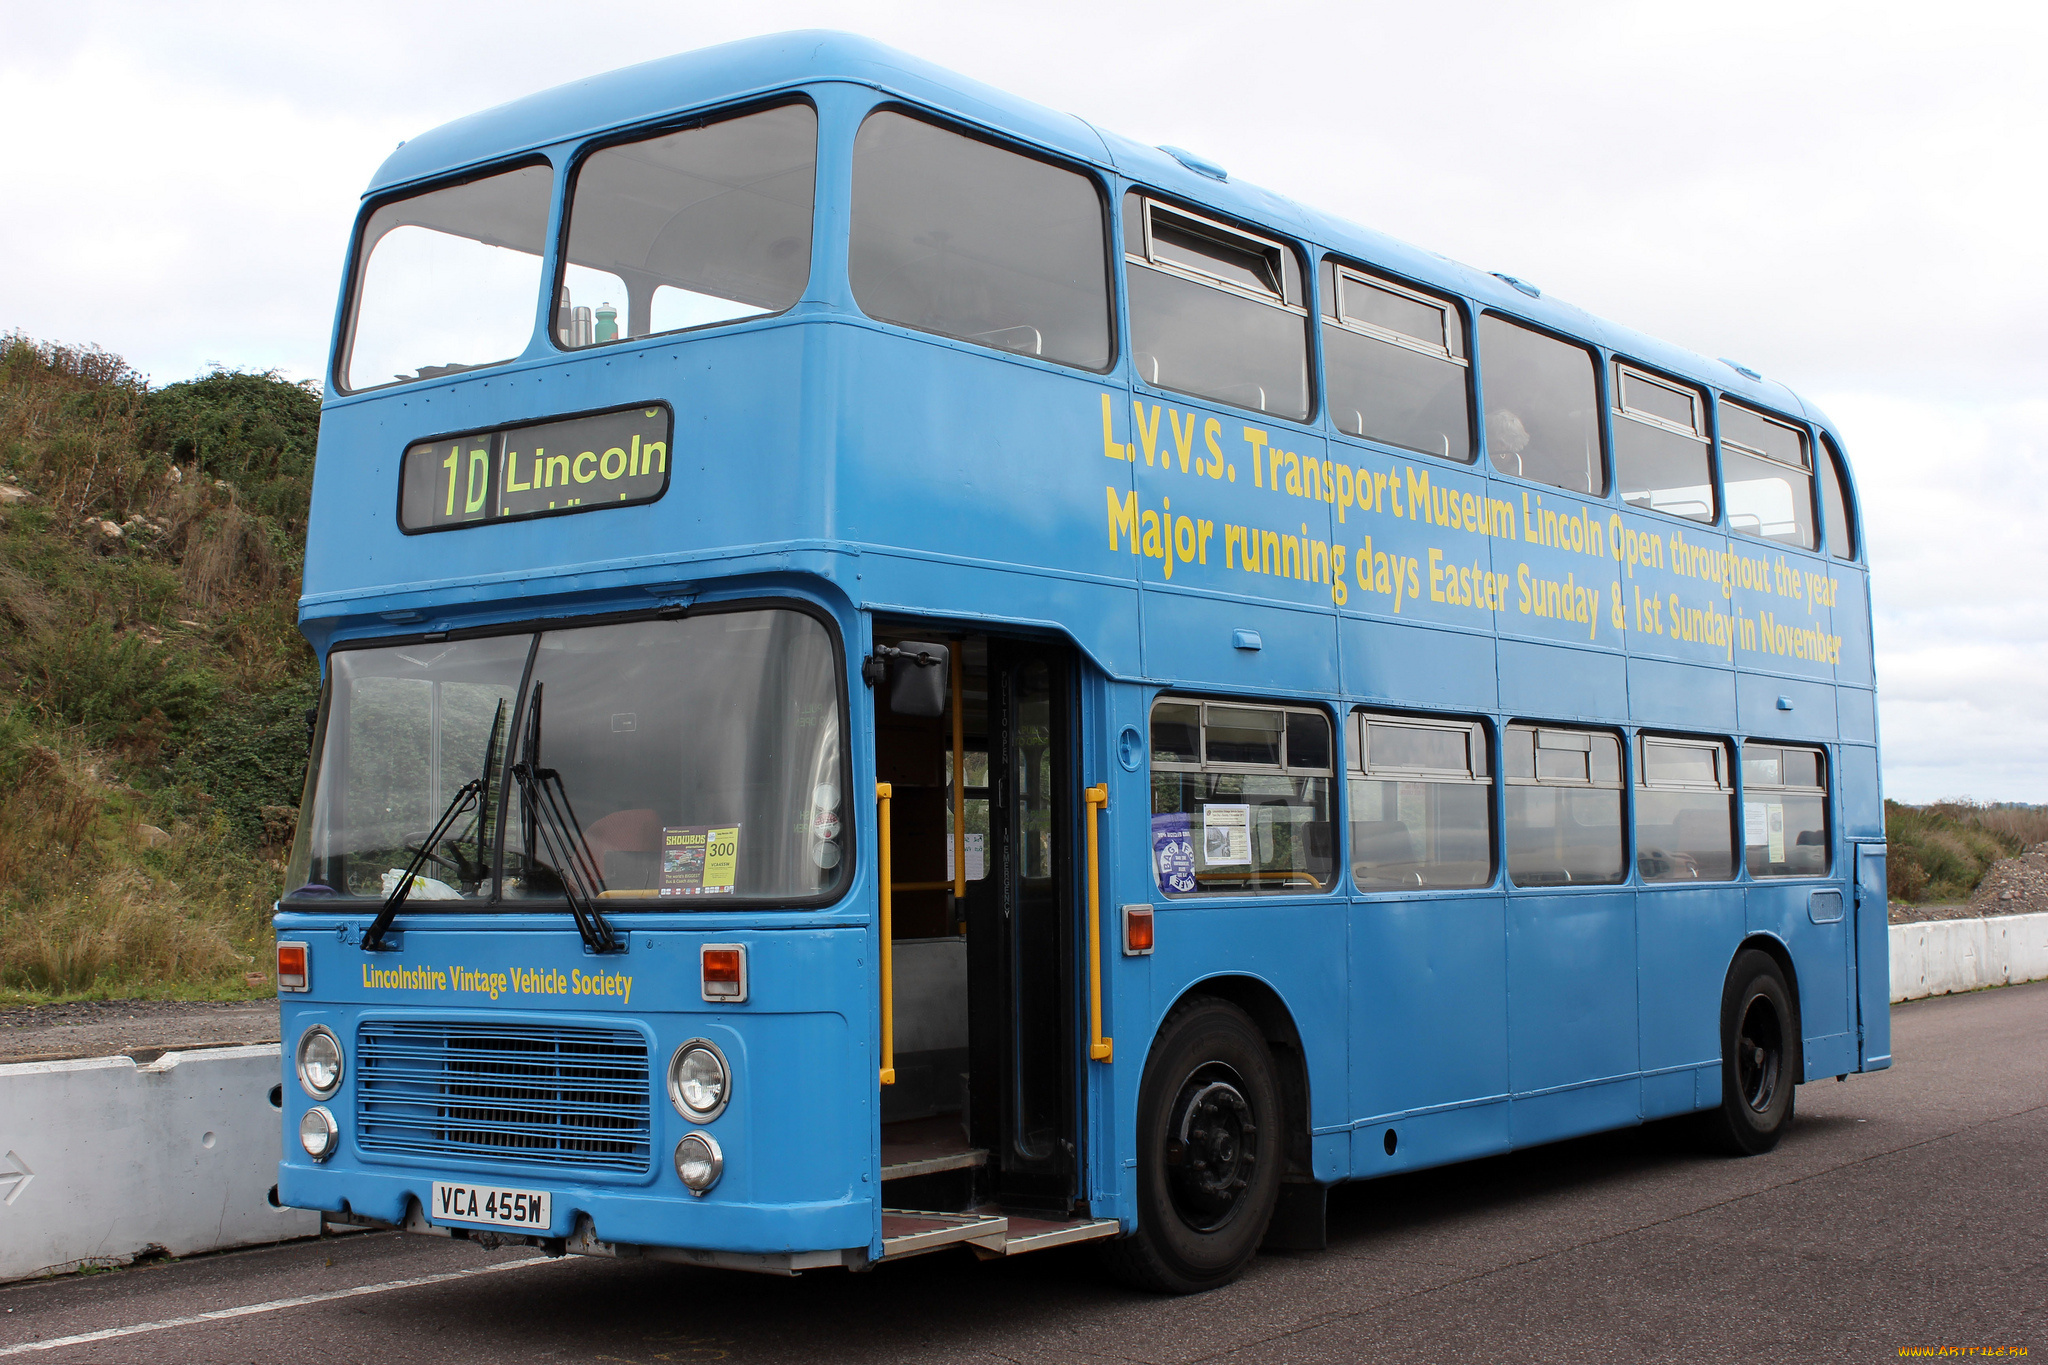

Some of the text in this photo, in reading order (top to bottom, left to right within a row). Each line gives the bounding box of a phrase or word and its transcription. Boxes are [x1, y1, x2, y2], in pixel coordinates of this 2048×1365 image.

[507, 435, 666, 492] Lincoln
[1101, 393, 1838, 614] L.V.V.S. Transport Museum Lincoln Open throughout the year
[1106, 486, 1213, 580] Major
[1225, 523, 1347, 605] running
[1355, 535, 1420, 613] days
[1428, 547, 1509, 611] Easter
[1517, 563, 1599, 640] Sunday
[1611, 581, 1627, 630] &
[1669, 593, 1734, 661] Sunday
[1738, 606, 1756, 651] in
[1760, 610, 1842, 665] November
[666, 835, 706, 846] SHOWBUS
[709, 843, 735, 857] 300
[362, 964, 632, 1004] Lincolnshire Vintage Vehicle Society
[441, 1186, 542, 1223] VCA 455W
